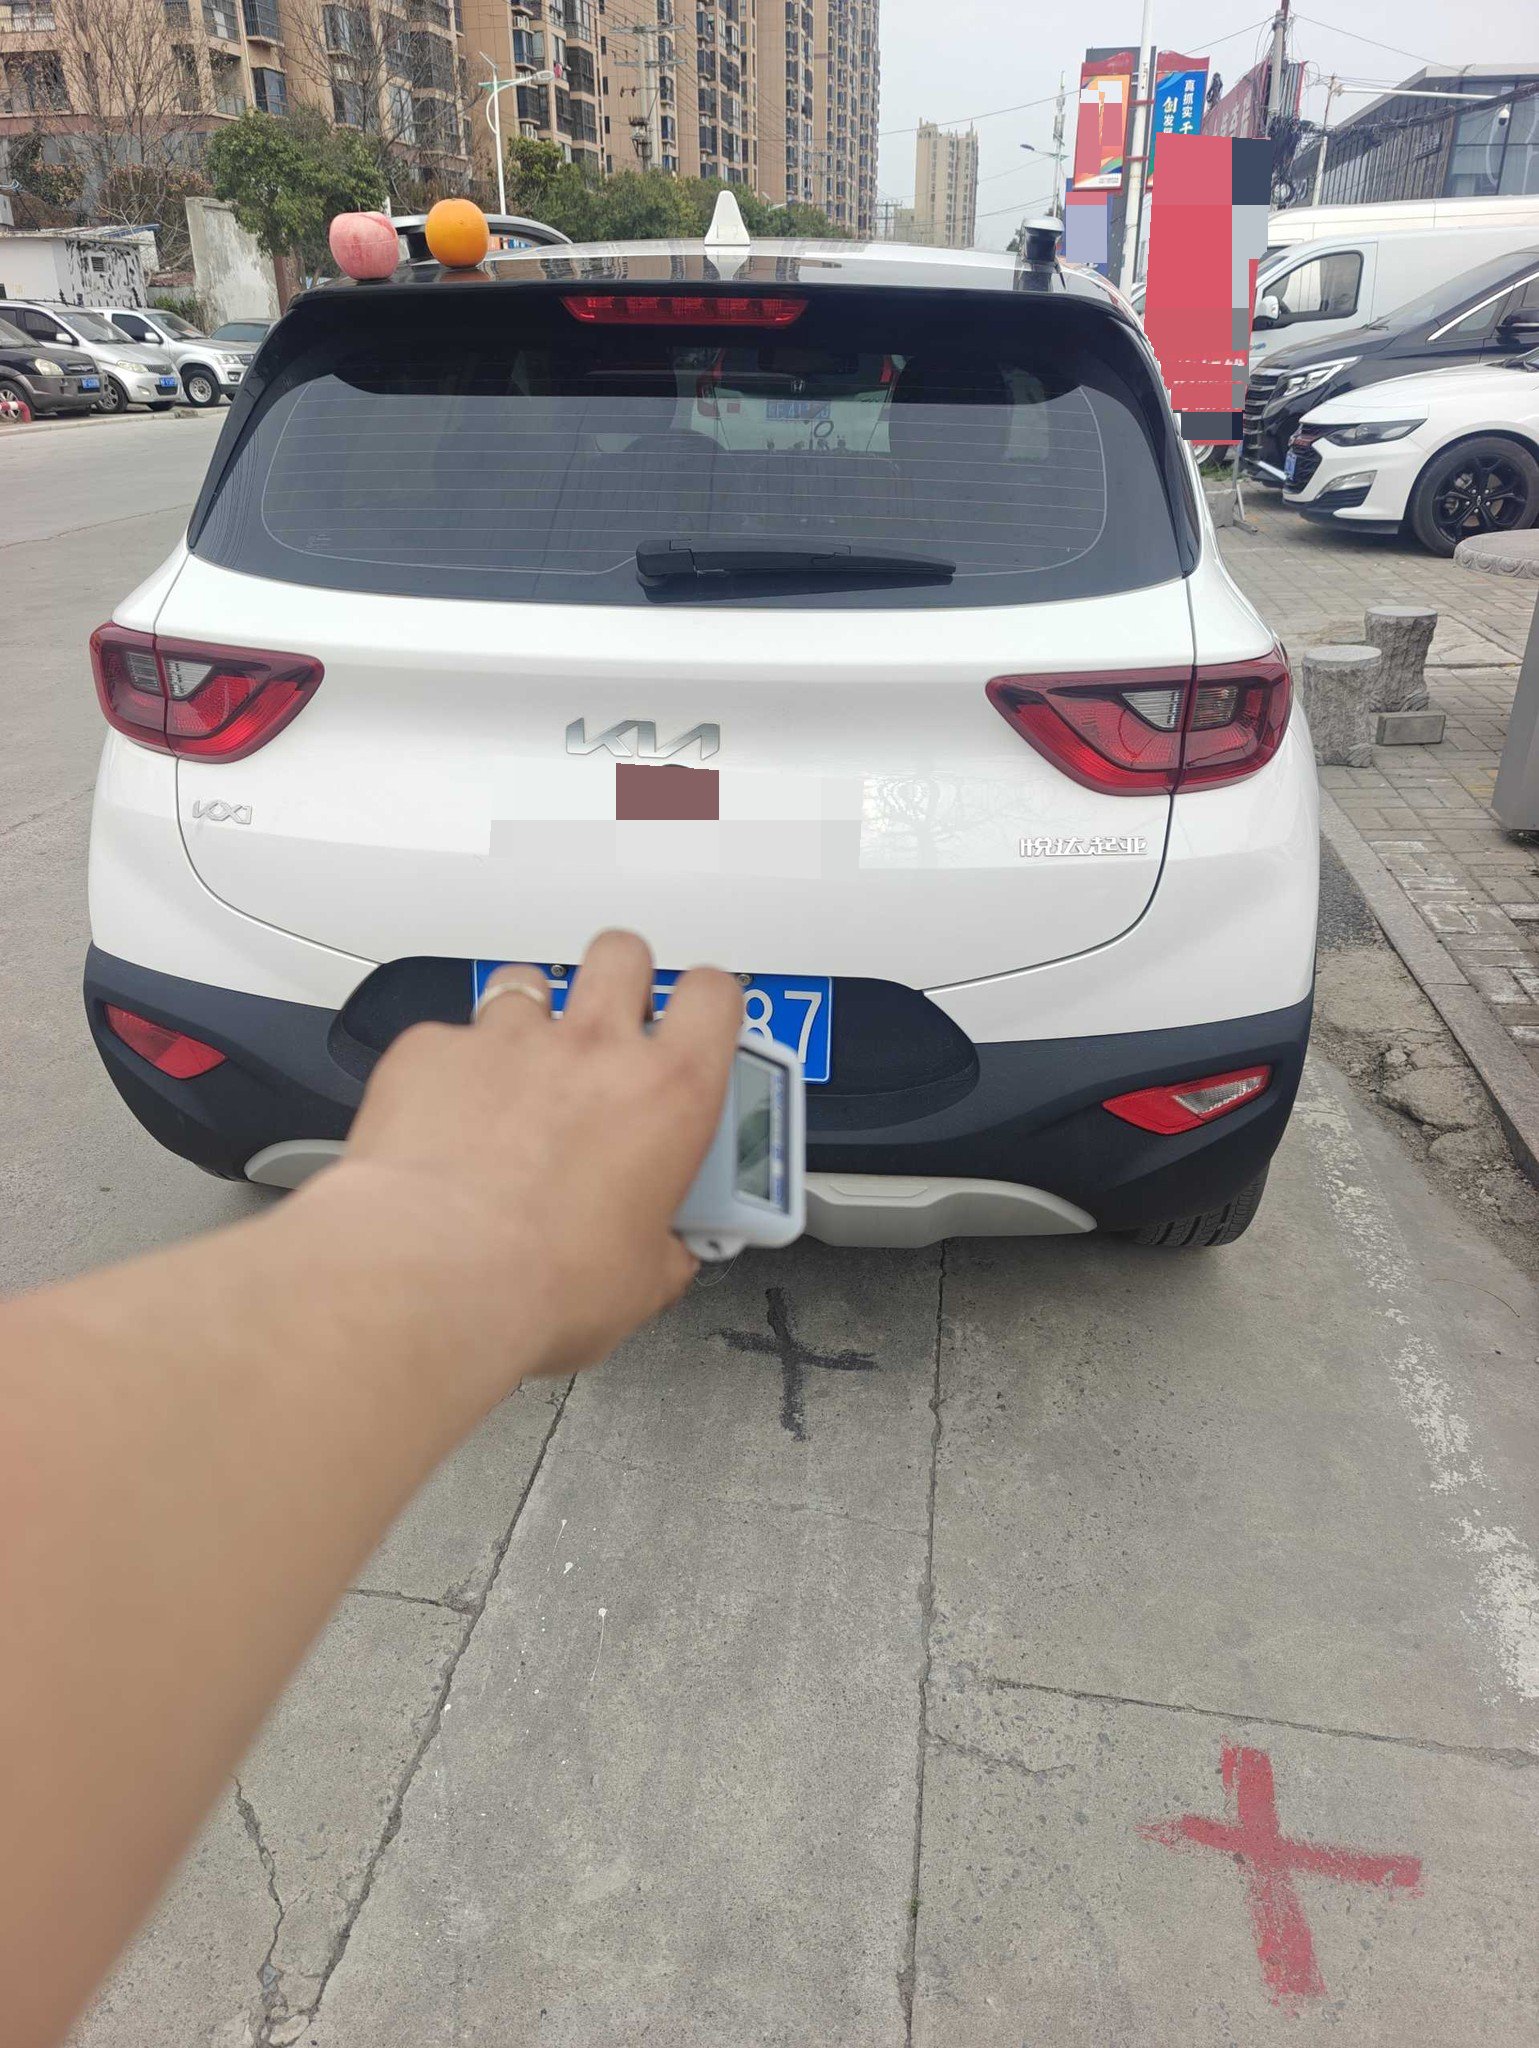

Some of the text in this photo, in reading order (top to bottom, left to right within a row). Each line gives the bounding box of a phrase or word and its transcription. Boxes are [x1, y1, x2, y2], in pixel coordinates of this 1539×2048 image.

[566, 717, 720, 760] KIA
[1019, 837, 1147, 857] 悦达起亚
